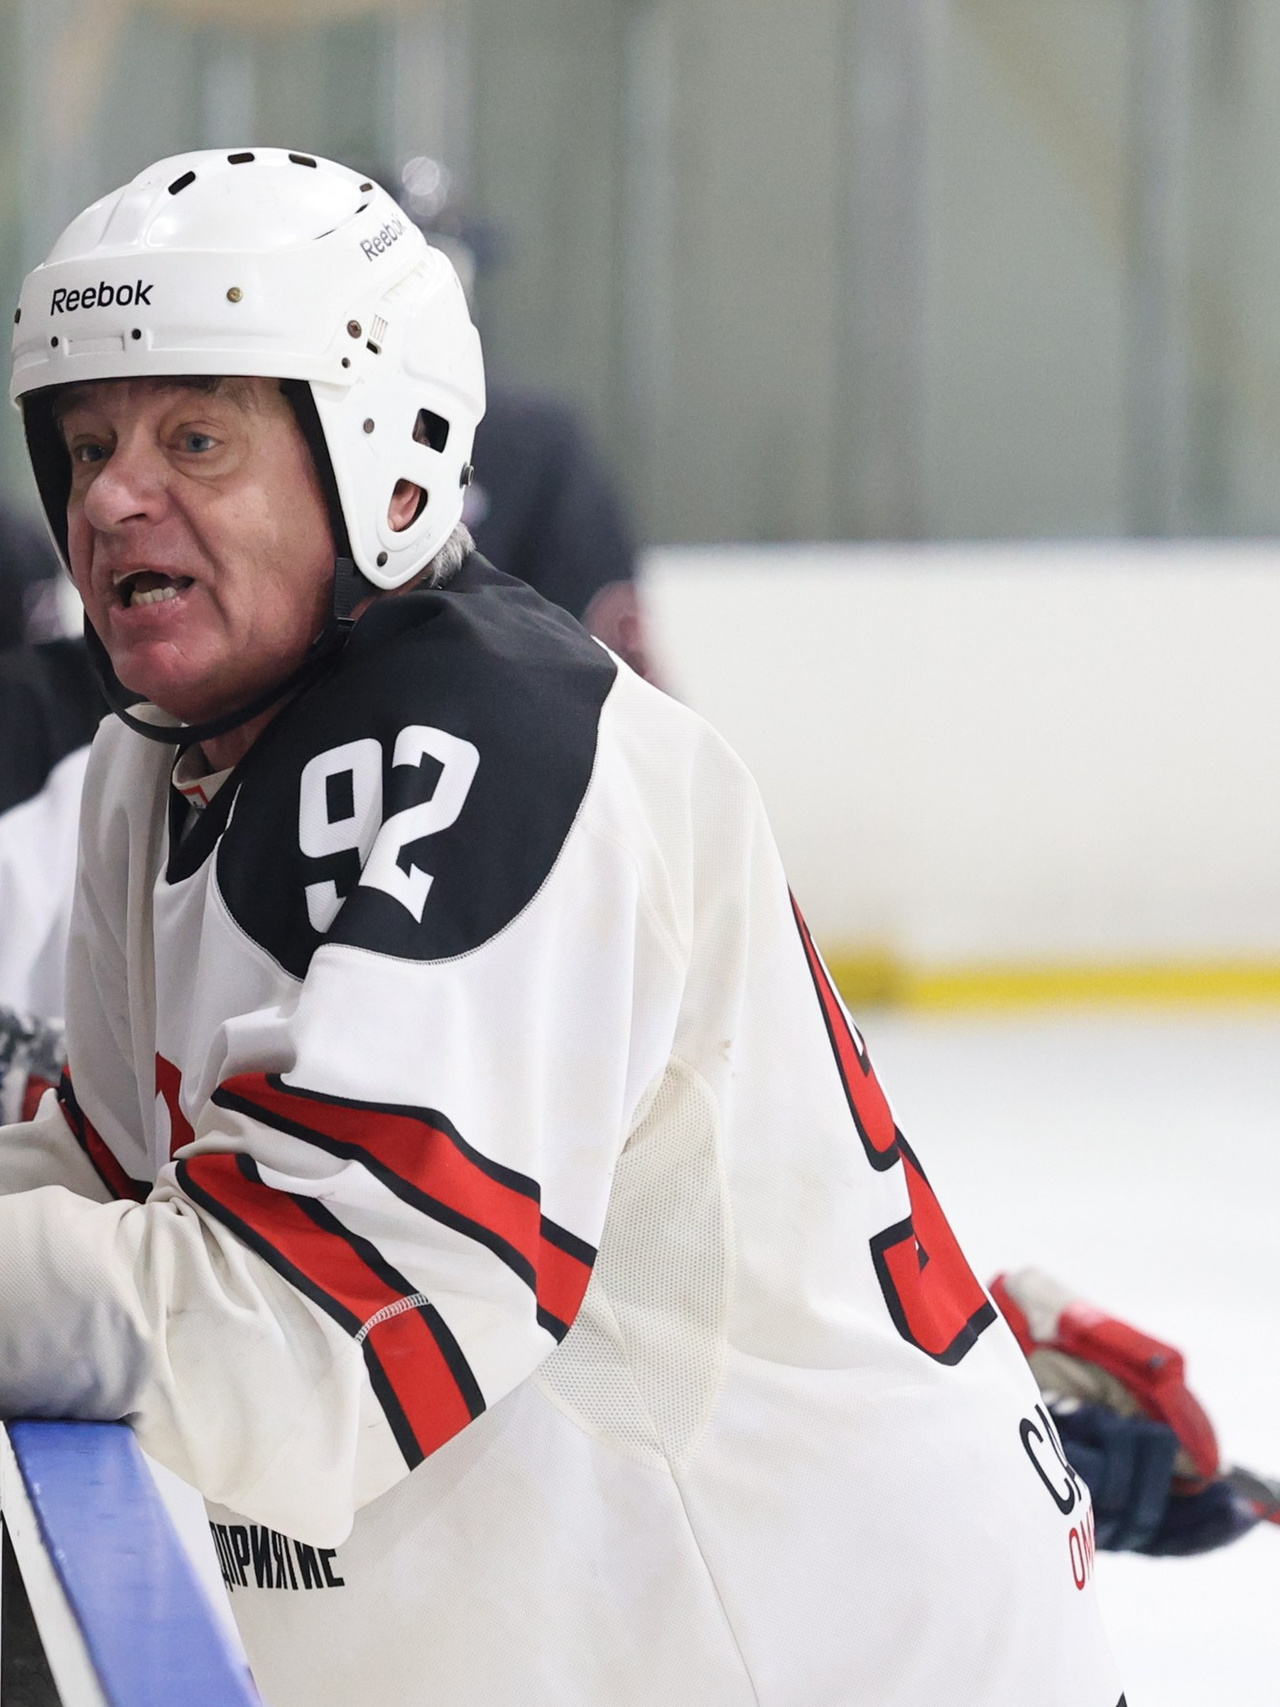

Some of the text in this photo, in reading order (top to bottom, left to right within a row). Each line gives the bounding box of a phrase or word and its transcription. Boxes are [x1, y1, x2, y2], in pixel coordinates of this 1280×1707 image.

[359, 213, 408, 263] Reebok
[50, 280, 154, 316] Reebok
[299, 724, 481, 935] 92
